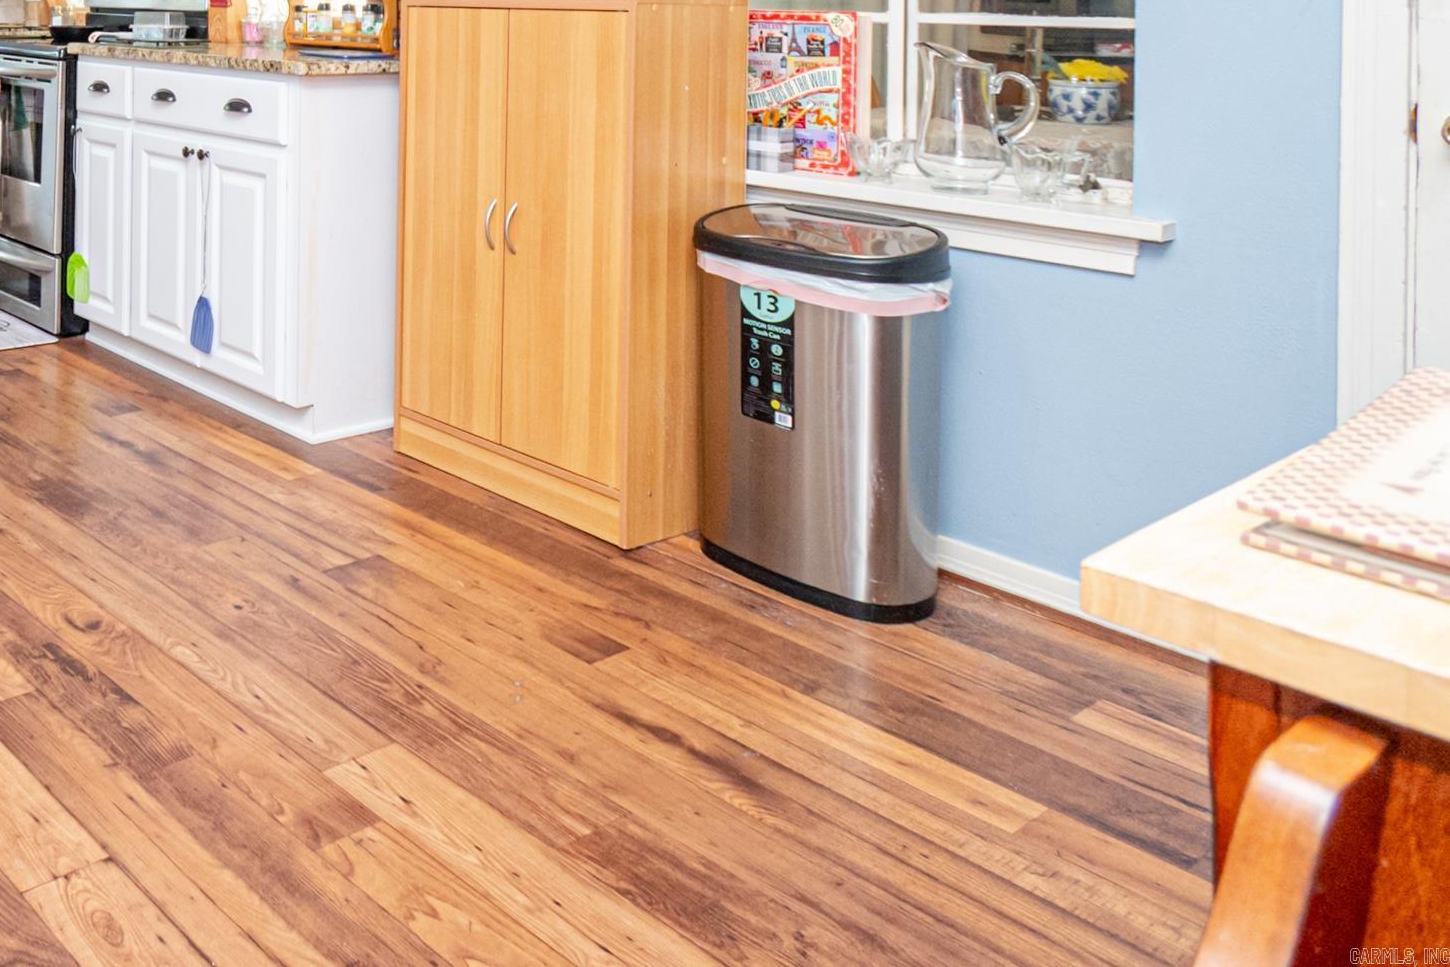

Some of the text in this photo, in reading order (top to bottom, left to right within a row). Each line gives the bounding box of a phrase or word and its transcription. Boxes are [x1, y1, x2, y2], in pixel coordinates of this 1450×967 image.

[808, 70, 838, 89] WORLD
[753, 291, 779, 314] 13
[767, 324, 792, 336] SENSOR
[768, 331, 781, 341] Can
